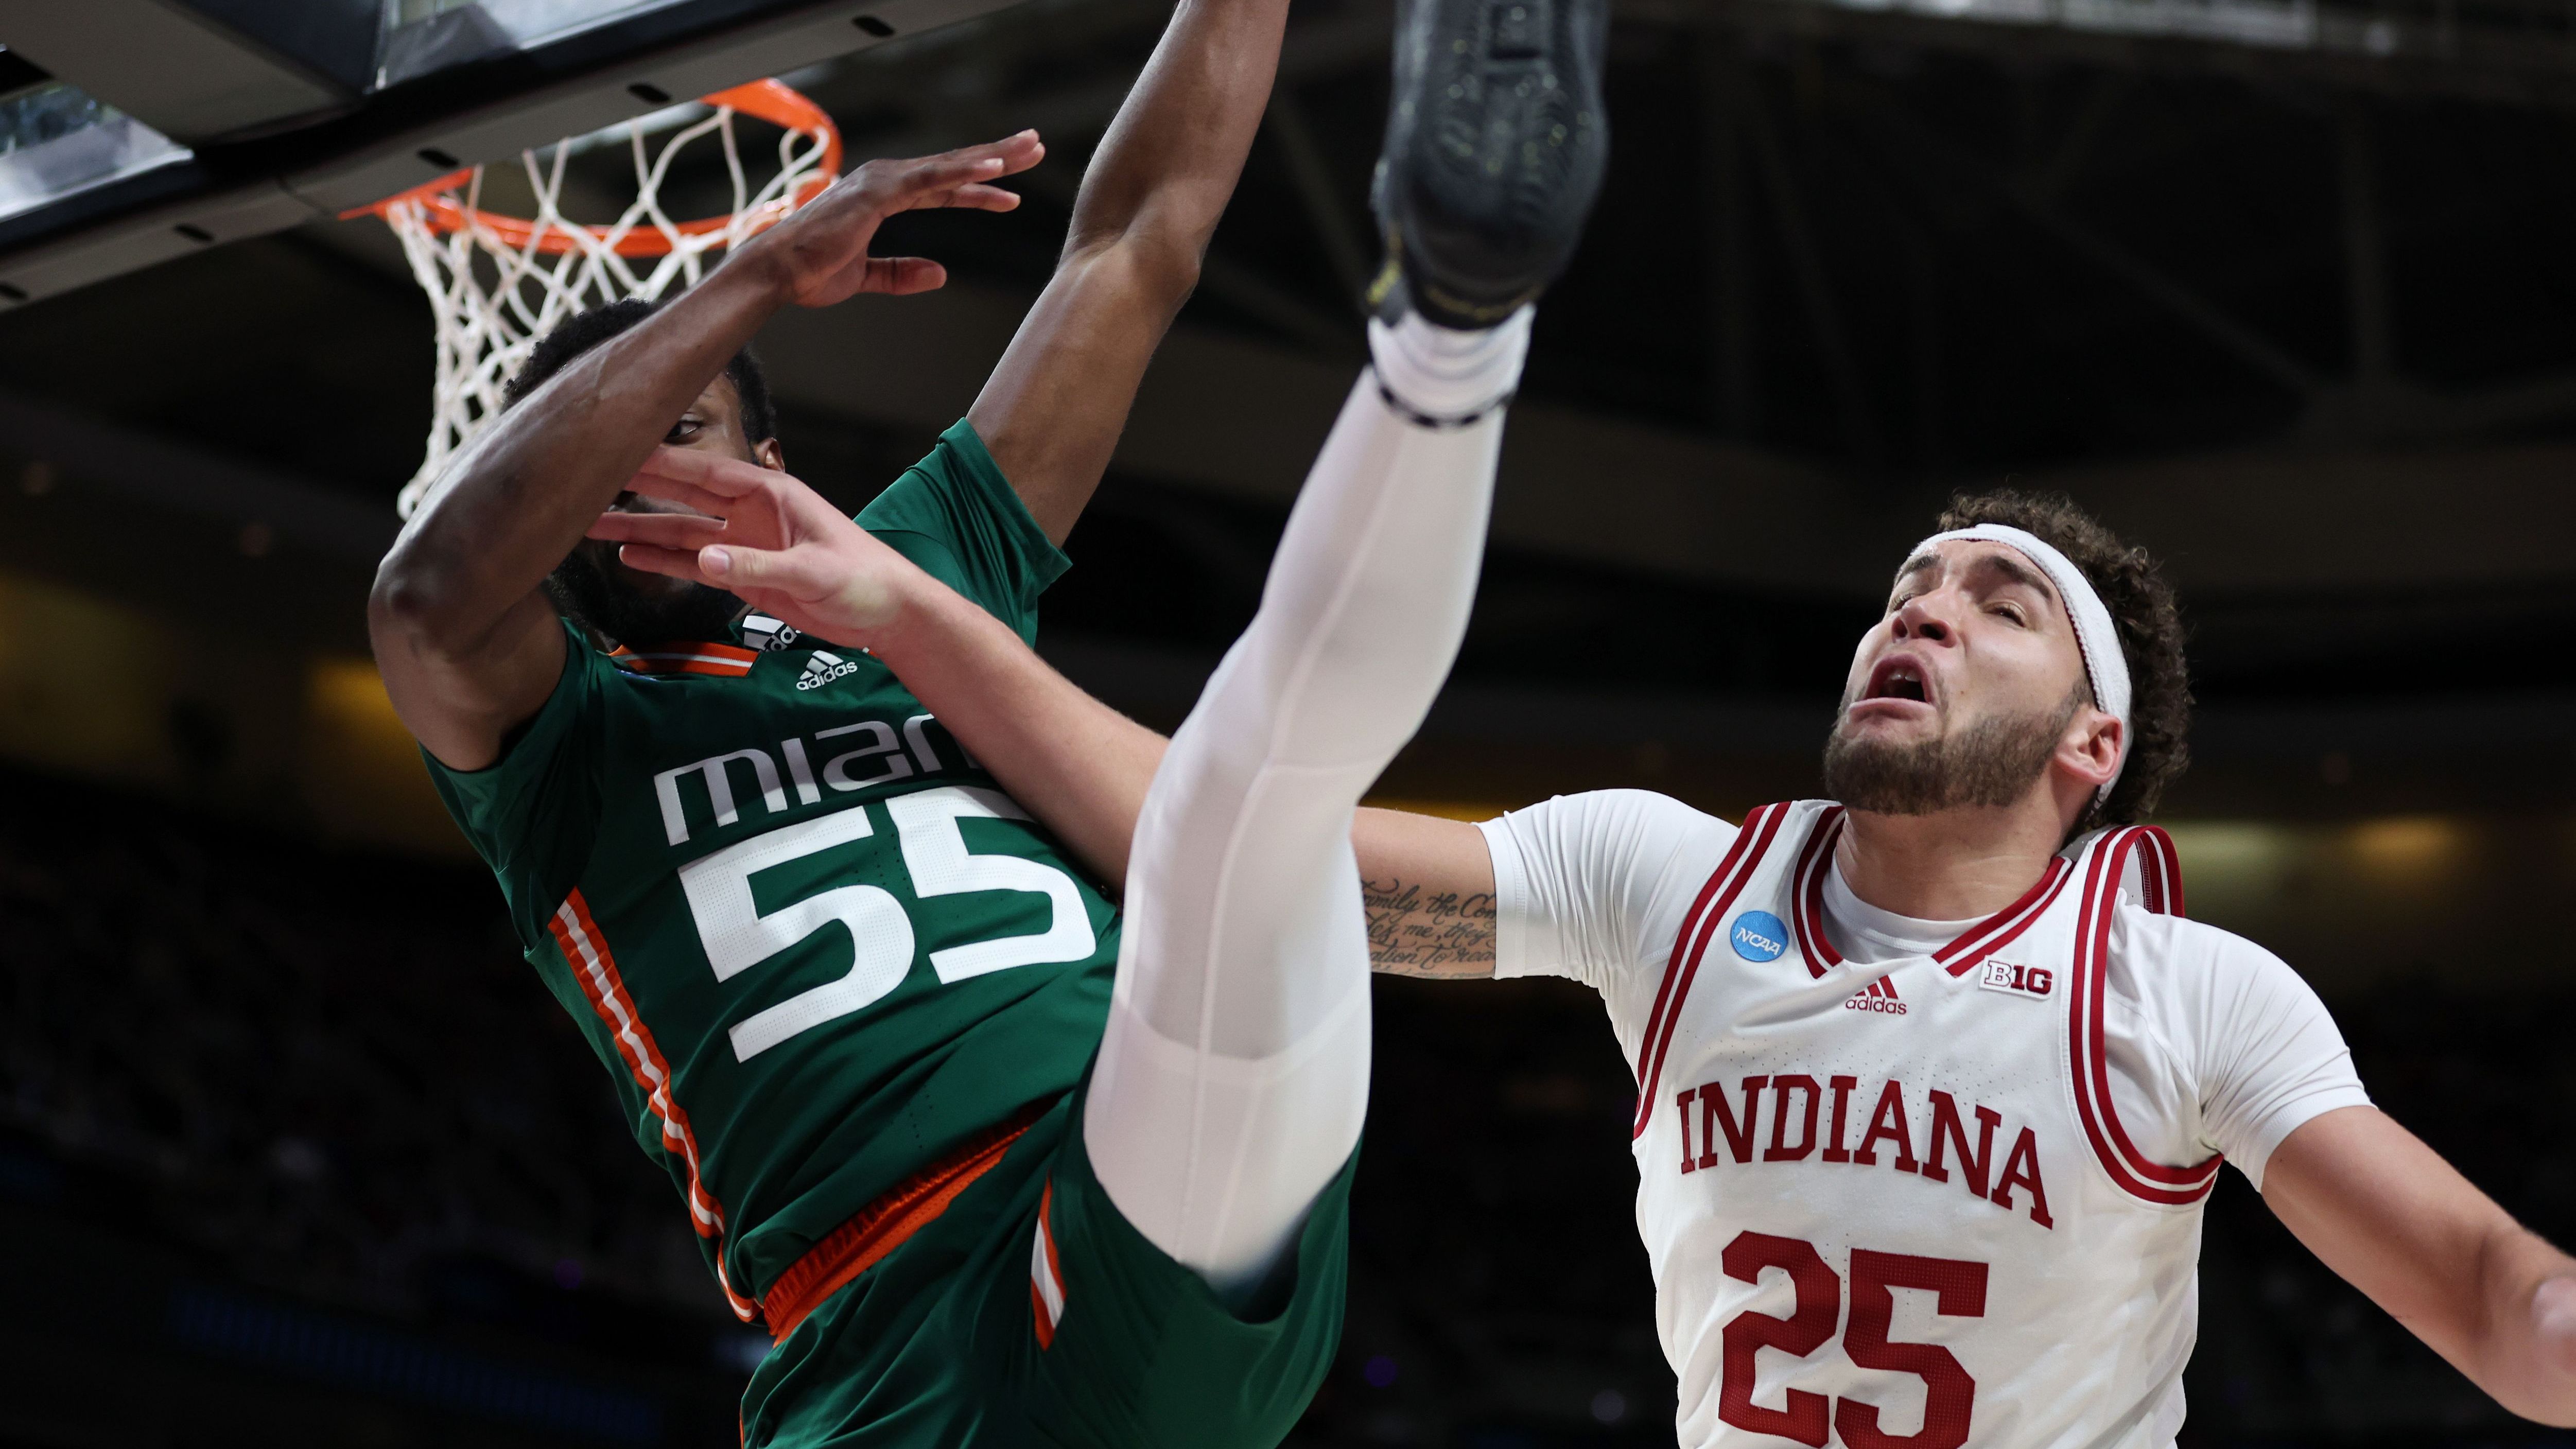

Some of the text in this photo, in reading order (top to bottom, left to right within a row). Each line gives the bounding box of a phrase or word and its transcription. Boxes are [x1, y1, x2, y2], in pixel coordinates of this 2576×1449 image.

[796, 661, 858, 691] adidas
[677, 785, 1096, 1063] 55
[1735, 927, 1781, 956] NCAA
[1845, 997, 1907, 1015] adidas
[1676, 1074, 2053, 1230] INDIANA
[1718, 1230, 1989, 1449] 25
